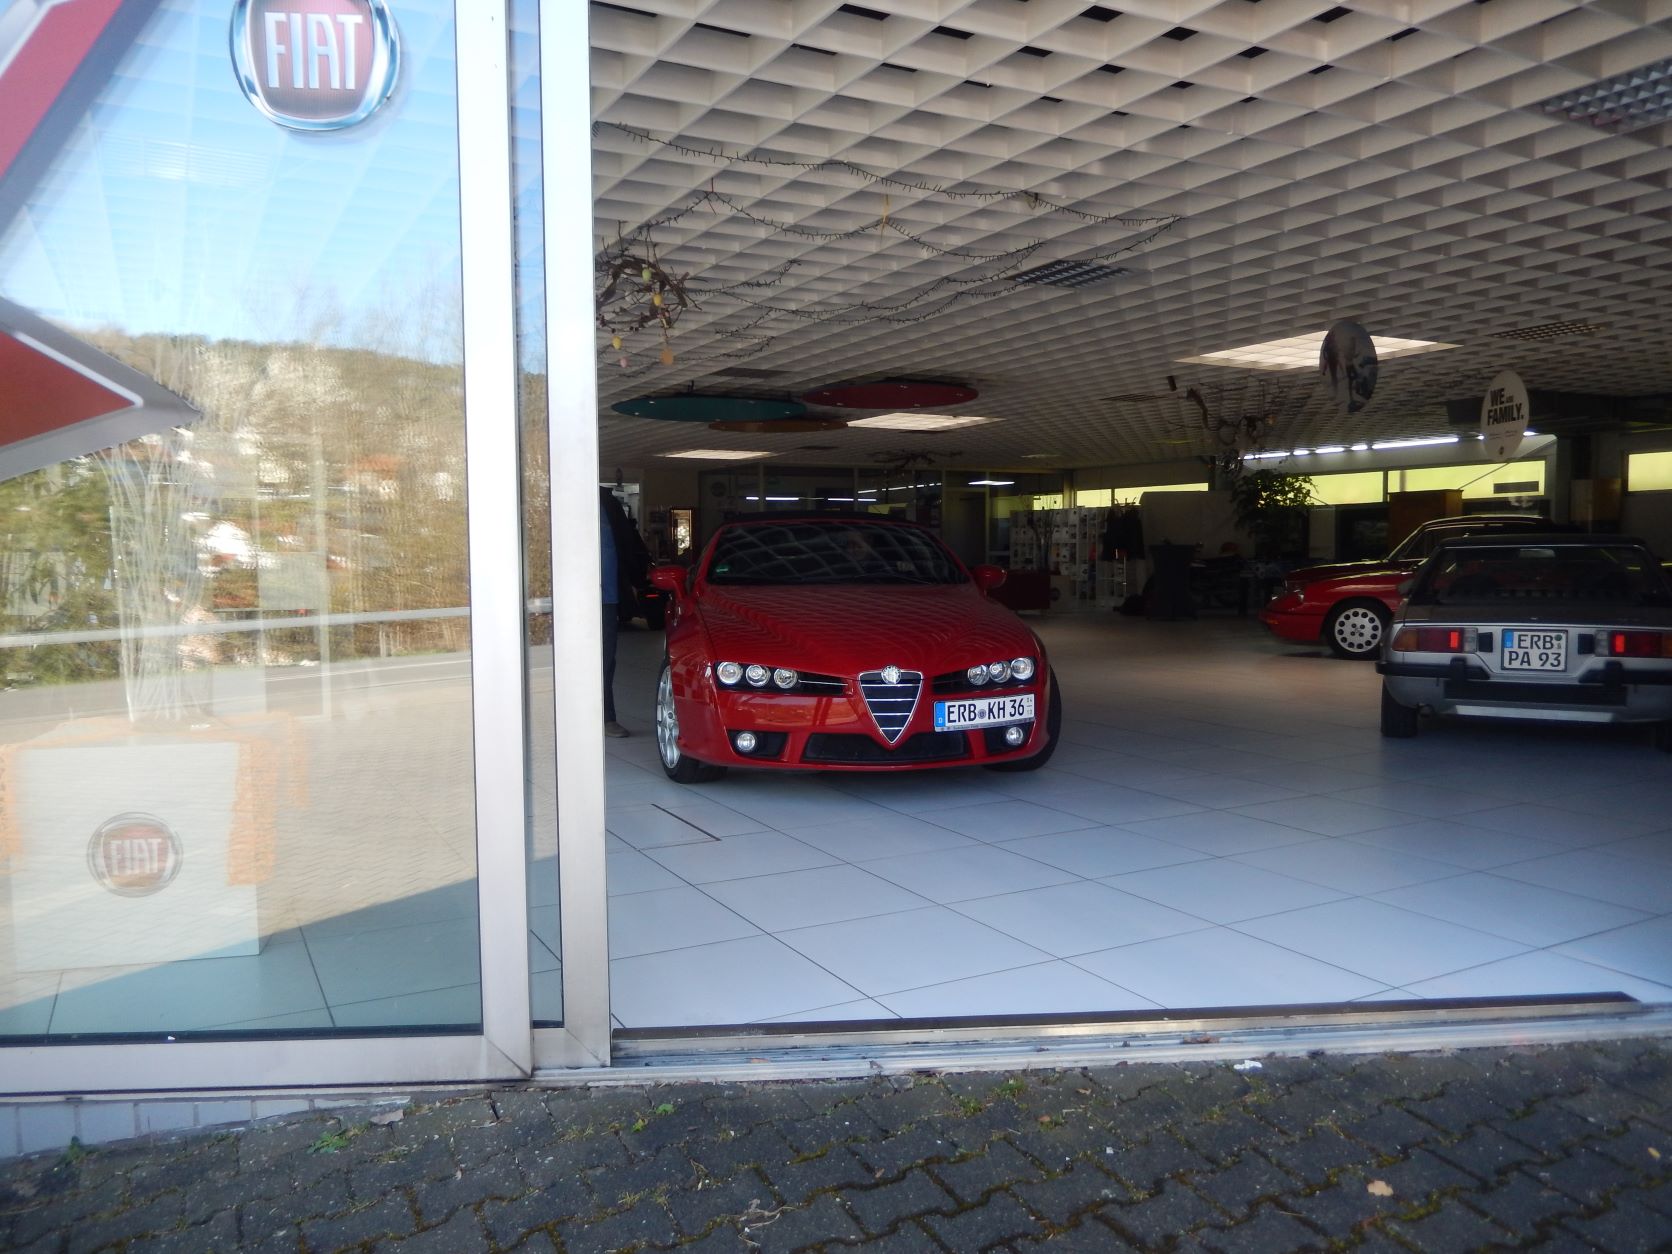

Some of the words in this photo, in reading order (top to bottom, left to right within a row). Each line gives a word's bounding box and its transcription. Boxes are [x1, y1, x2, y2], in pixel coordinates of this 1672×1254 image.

[264, 11, 363, 90] FIAT
[1490, 388, 1505, 407] WE
[1487, 403, 1524, 426] FAMILY.
[1518, 634, 1554, 650] ERB
[1508, 651, 1532, 667] PA
[1538, 652, 1561, 668] 93
[947, 703, 977, 724] ERB
[988, 700, 1006, 720] KH
[1009, 698, 1025, 718] 36
[110, 838, 162, 876] FIAT
